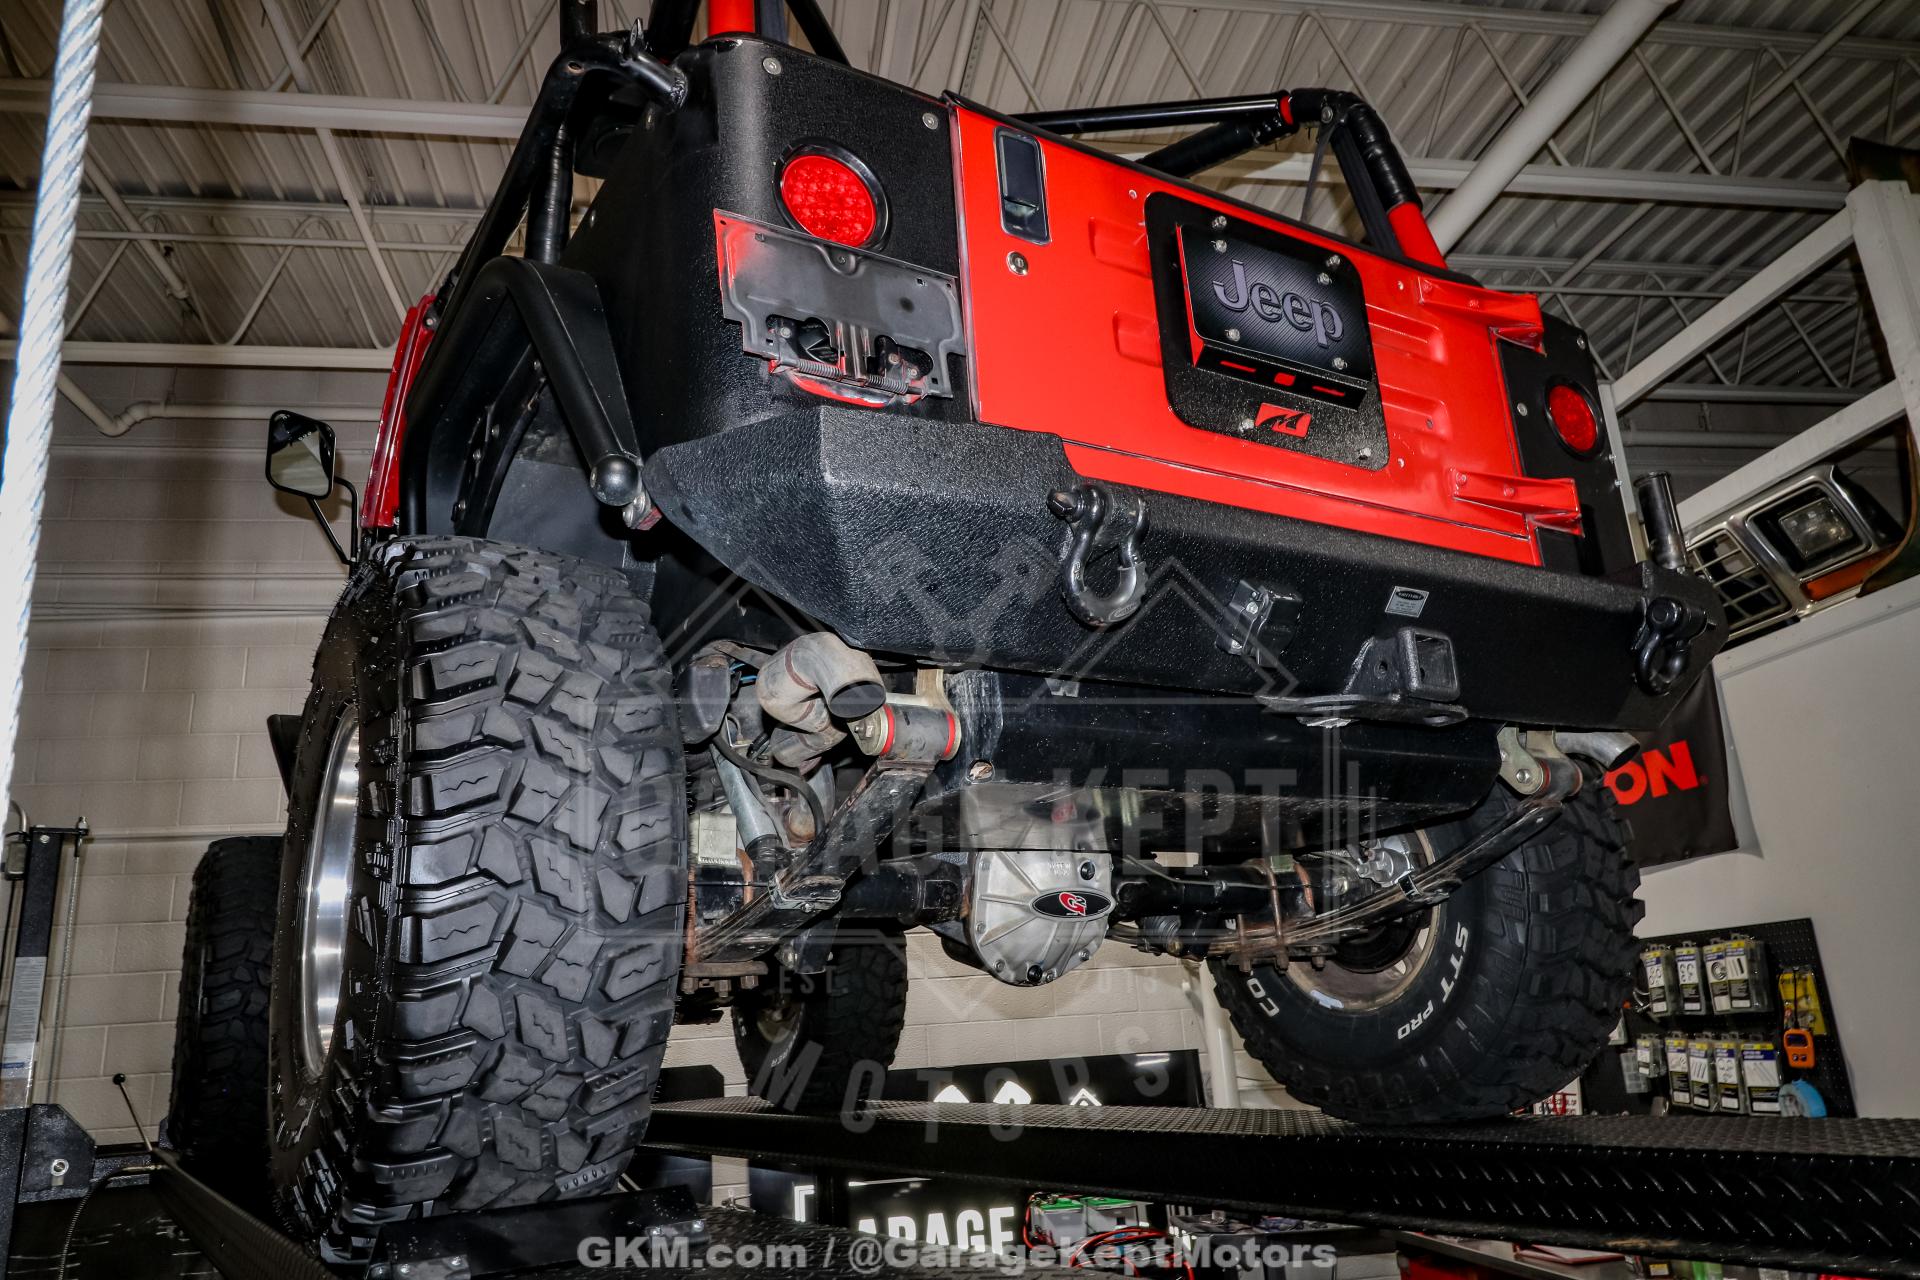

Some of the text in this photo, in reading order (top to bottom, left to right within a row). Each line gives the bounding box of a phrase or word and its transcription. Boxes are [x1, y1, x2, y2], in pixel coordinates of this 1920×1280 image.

[1212, 259, 1345, 349] Jeep
[1059, 892, 1087, 917] G2
[1397, 921, 1469, 1040] STT PRO
